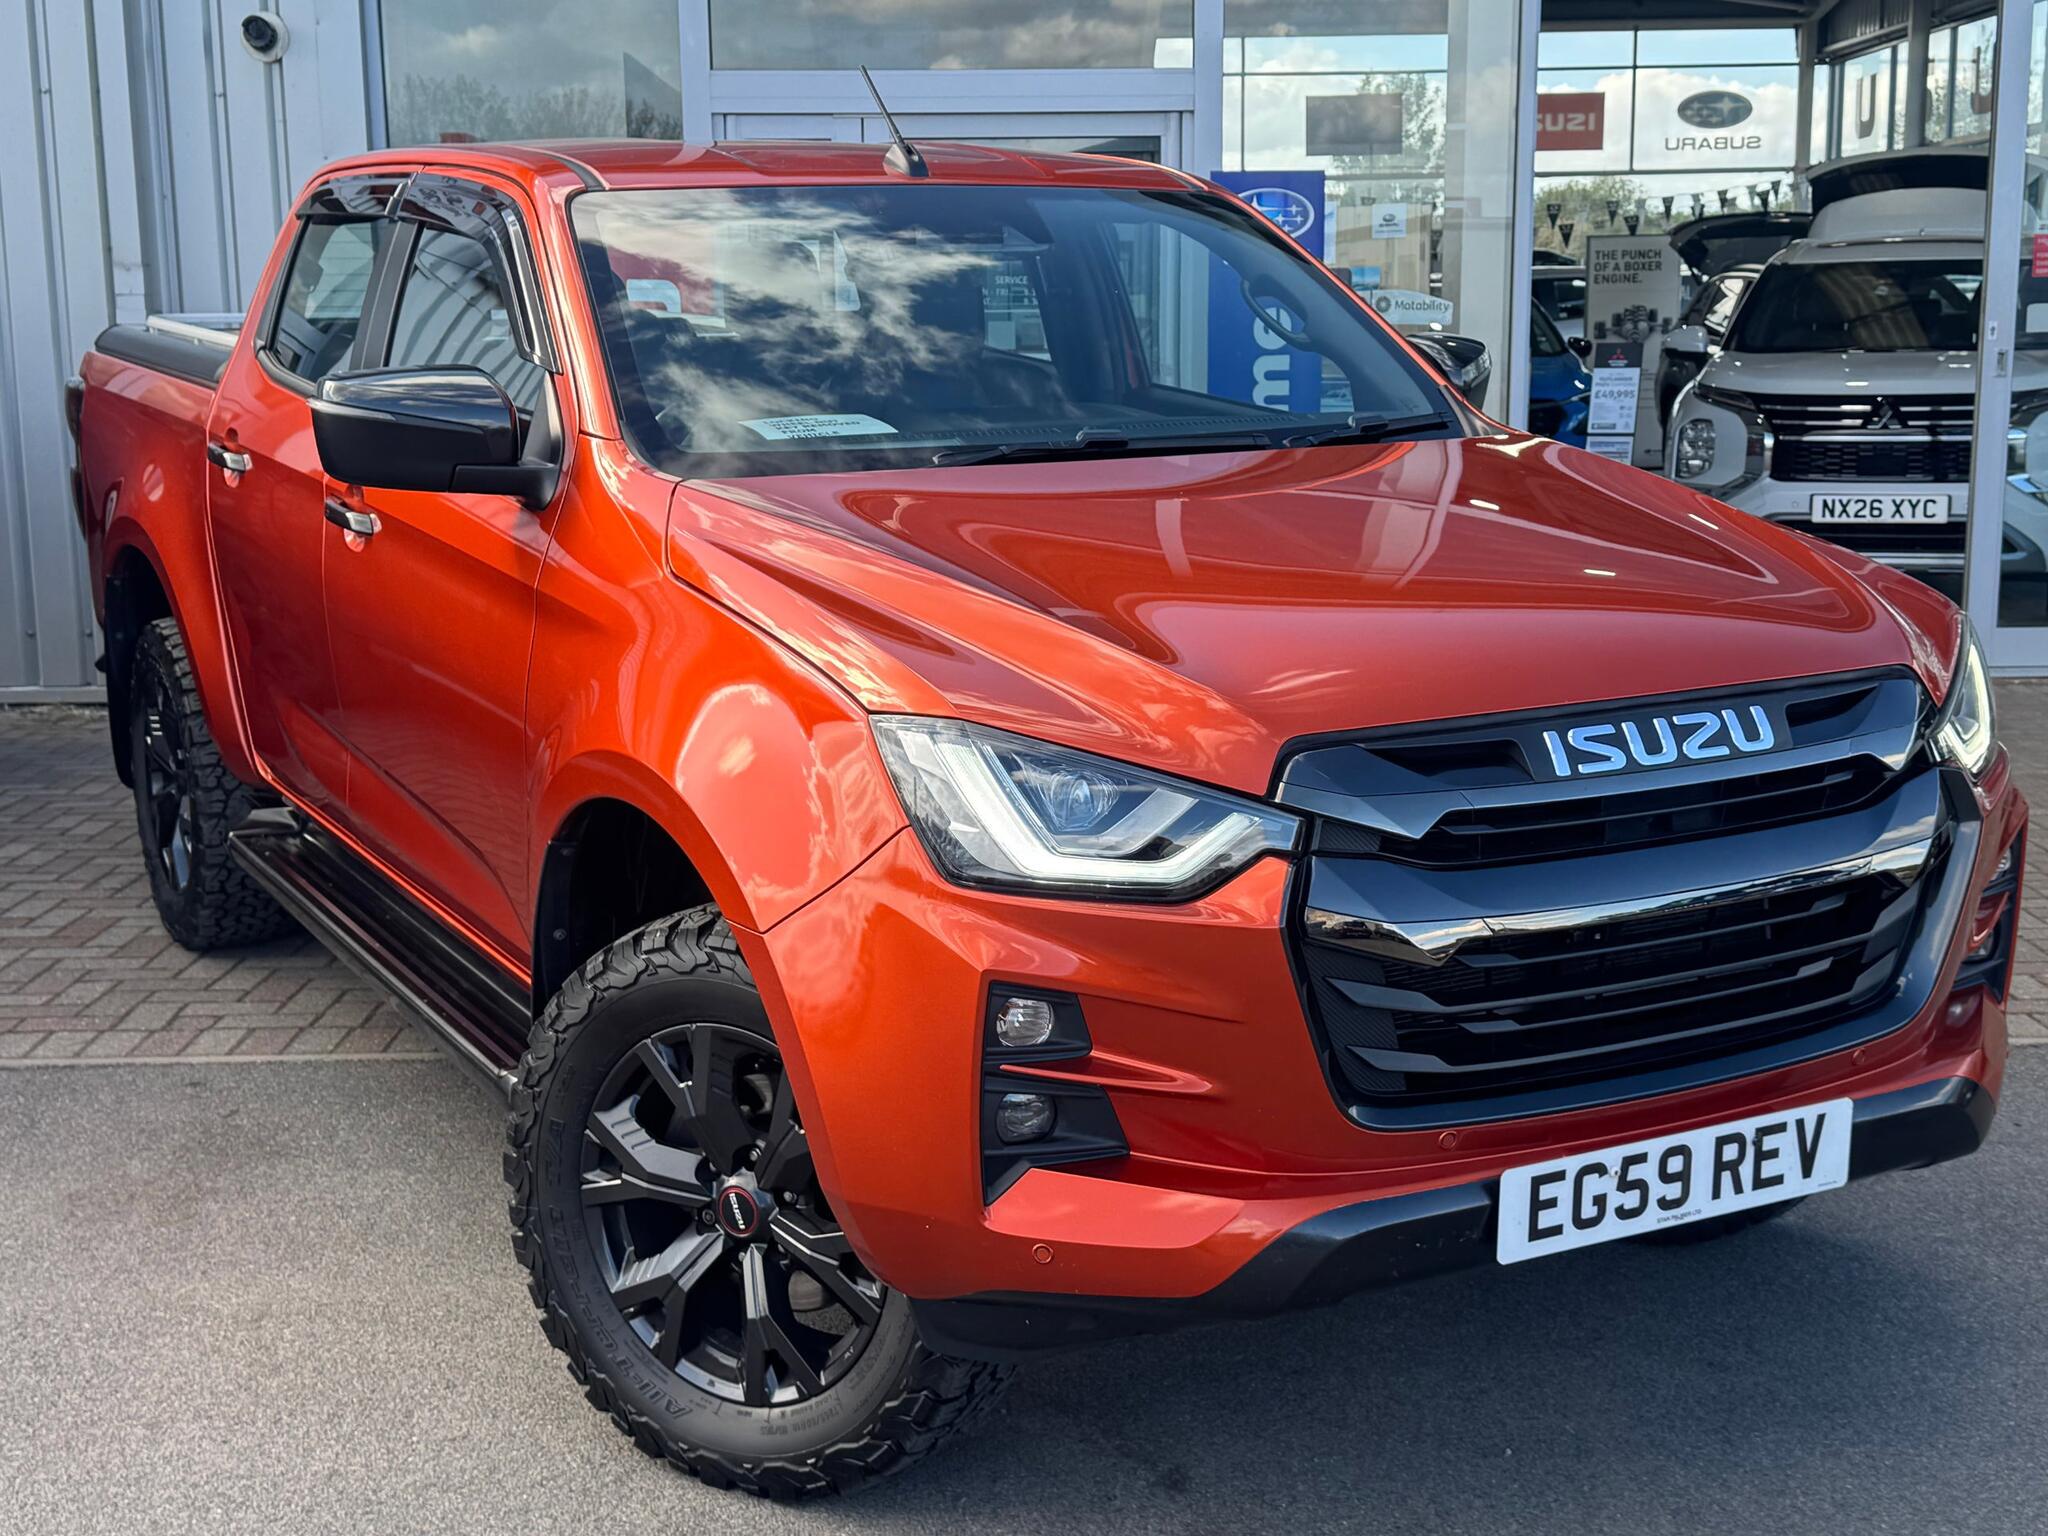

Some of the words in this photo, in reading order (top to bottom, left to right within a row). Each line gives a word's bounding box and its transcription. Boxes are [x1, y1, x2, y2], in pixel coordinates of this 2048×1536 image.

[1594, 250, 1619, 260] THE
[1621, 249, 1662, 260] PUNCH
[1593, 262, 1609, 272] OF
[1612, 262, 1620, 272] A
[1624, 261, 1663, 272] BOXER
[995, 275, 1028, 285] SERVICE
[1593, 273, 1642, 285] ENGINE.
[1394, 300, 1450, 313] Motability
[1821, 499, 1883, 518] NX26
[1891, 499, 1937, 518] XYC
[1542, 705, 1775, 777] ISUZU
[1528, 1144, 1693, 1243] EG59
[1711, 1112, 1827, 1201] REV
[728, 1192, 747, 1231] ISUZU
